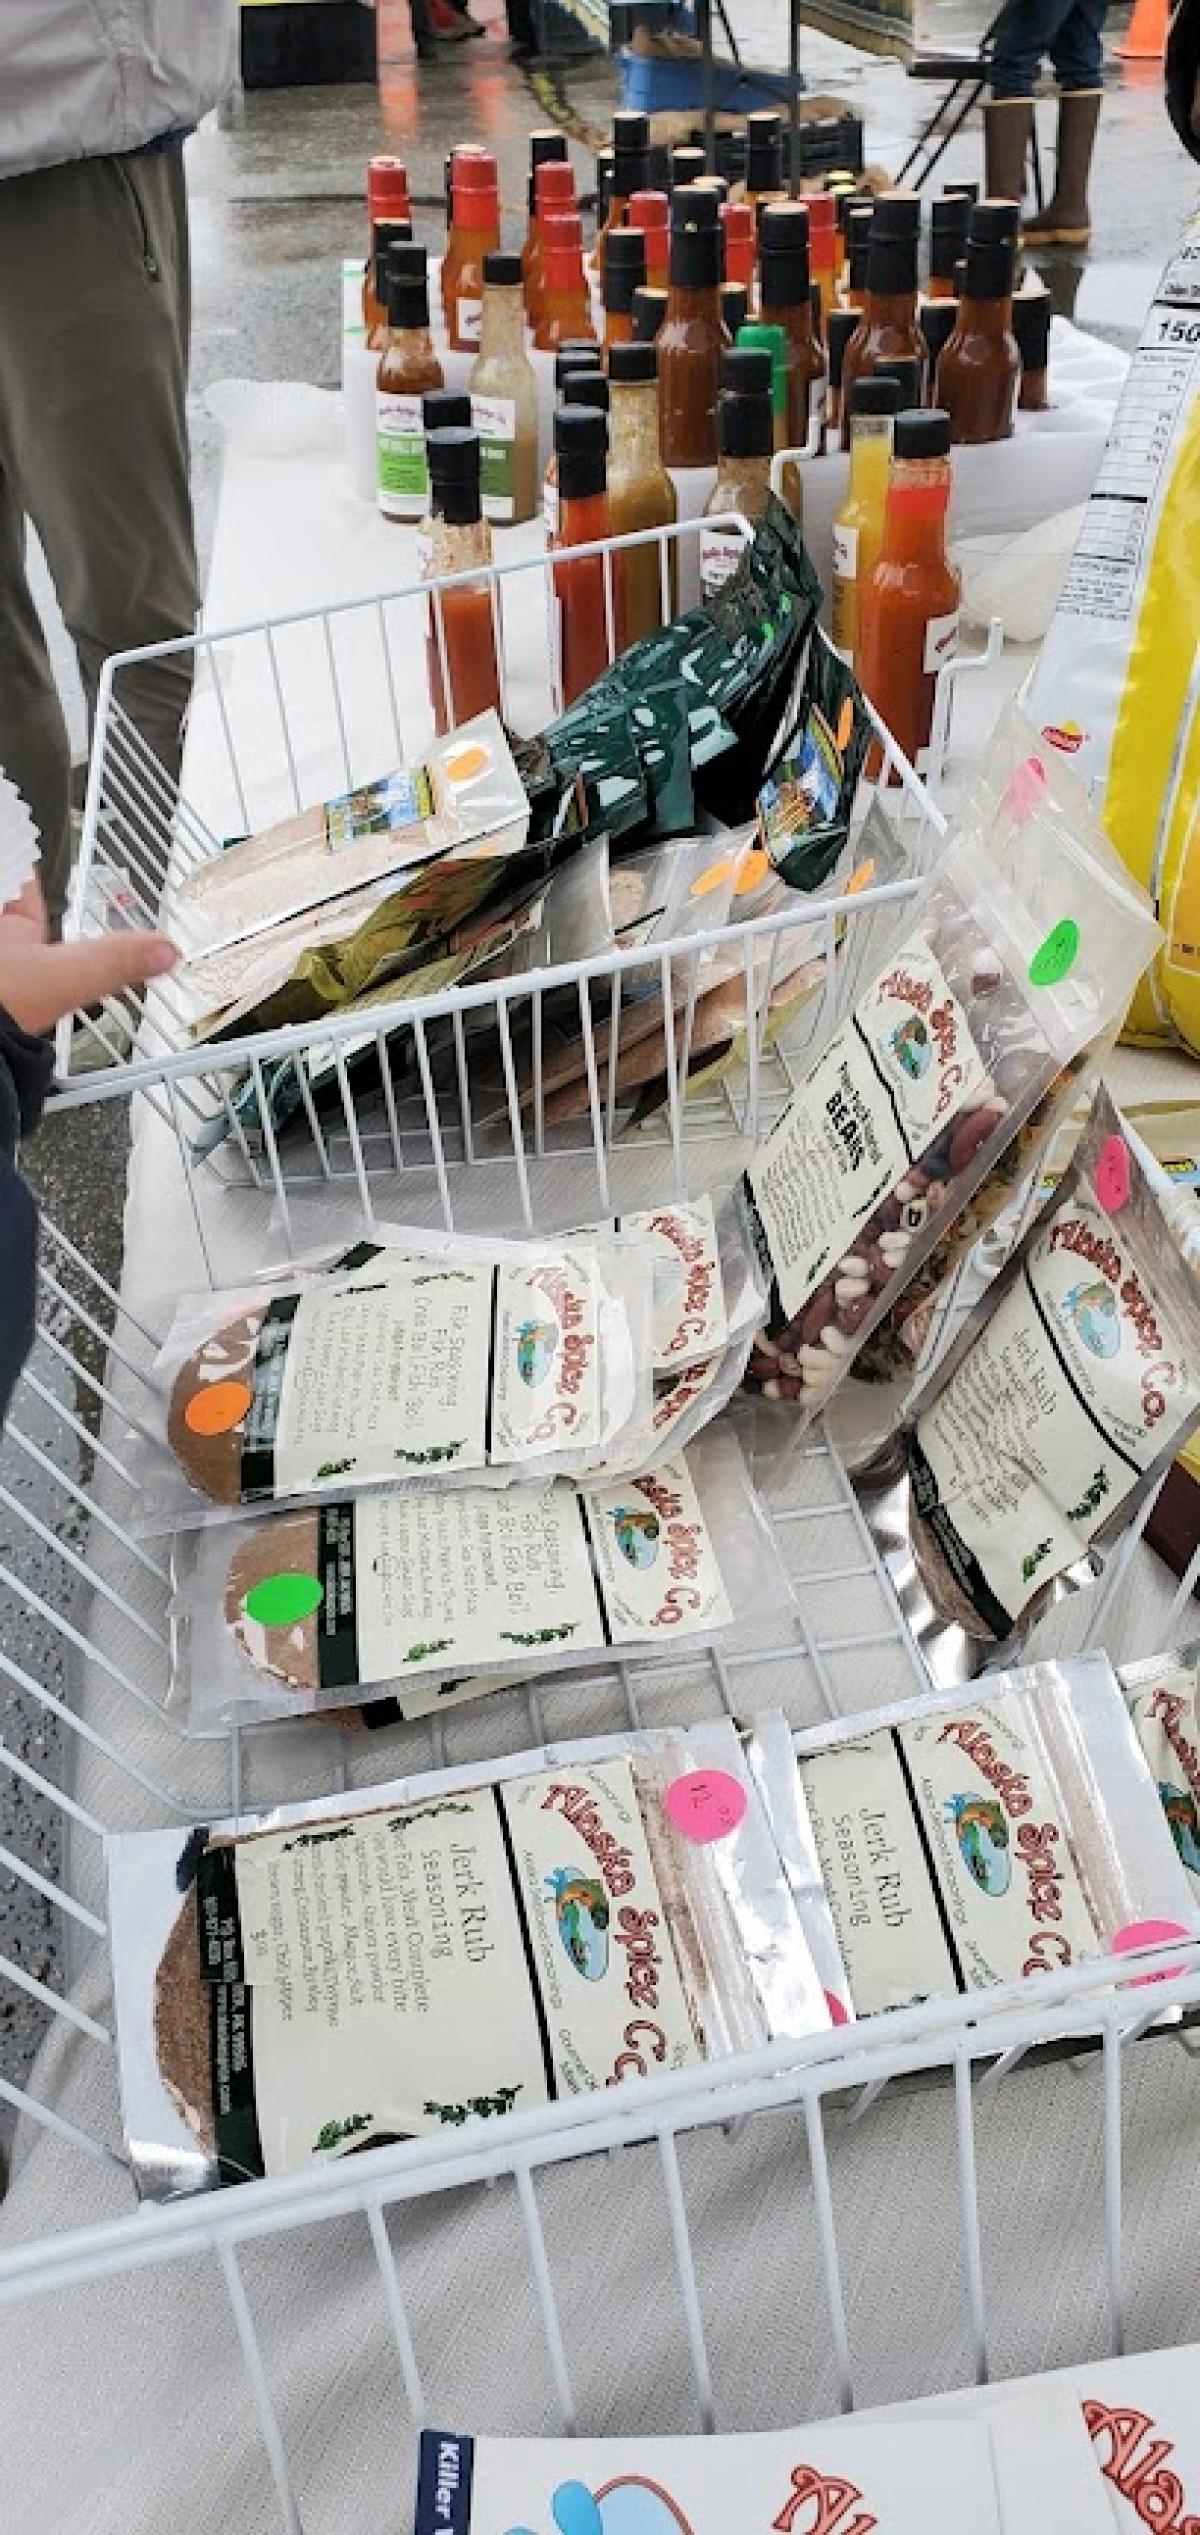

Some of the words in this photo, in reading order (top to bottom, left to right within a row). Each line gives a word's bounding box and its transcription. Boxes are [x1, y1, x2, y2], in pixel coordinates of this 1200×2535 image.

[826, 1090, 863, 1170] BEANS
[526, 1264, 586, 1328] Alaska
[556, 1335, 593, 1395] Spice
[631, 1476, 683, 1518] aska
[663, 1523, 700, 1578] Spice
[858, 1810, 896, 1864] Jerk
[935, 1719, 1034, 1819] Alaska
[1015, 1821, 1063, 1924] Spice
[418, 1849, 456, 1958] Seasoning
[449, 1841, 483, 1897] Jerk
[541, 1786, 635, 1896] Alaska
[614, 1908, 658, 2009] Spice
[831, 1813, 871, 1926] Seasoning
[875, 1871, 910, 1926] Rub
[459, 1905, 495, 1963] Rub
[434, 2441, 460, 2520] Killer
